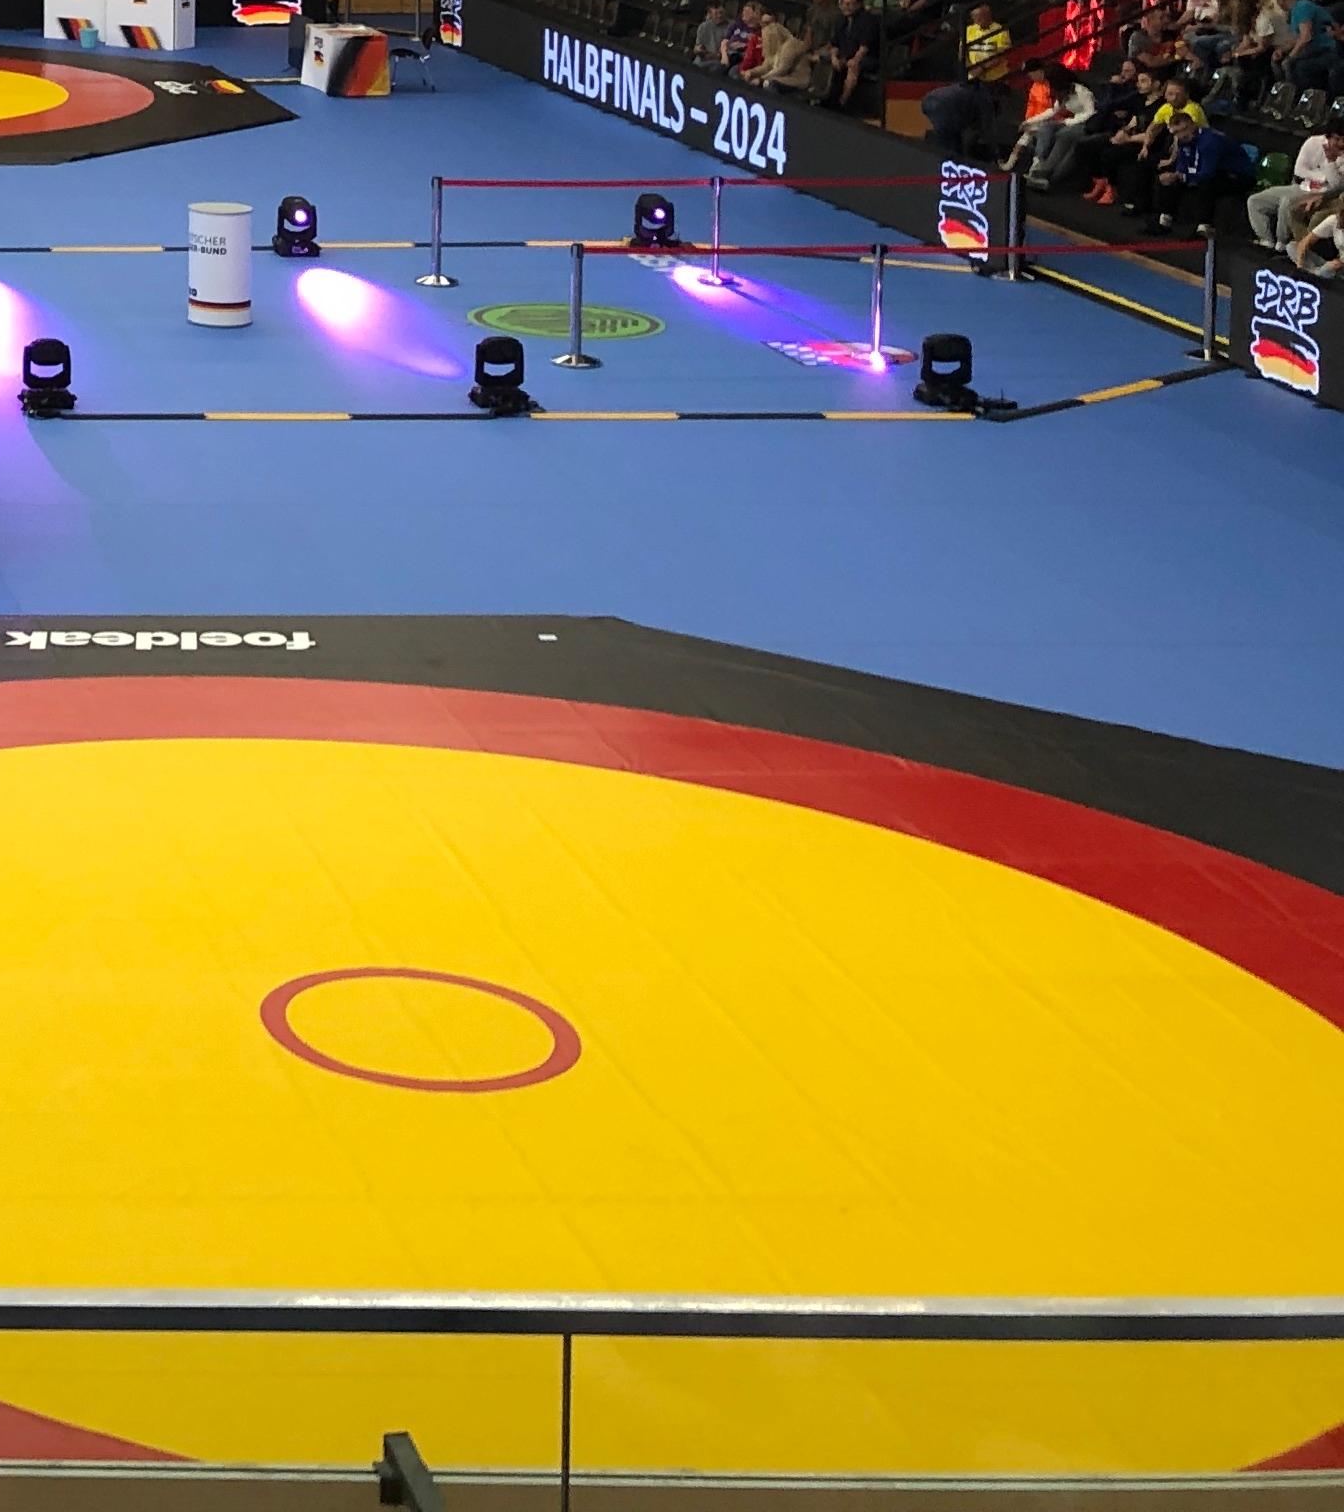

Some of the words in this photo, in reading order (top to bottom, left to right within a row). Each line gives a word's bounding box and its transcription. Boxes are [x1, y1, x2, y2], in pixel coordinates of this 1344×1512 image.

[543, 28, 685, 134] HALBFINALS
[713, 90, 787, 176] 2024
[1254, 269, 1321, 325] DRB
[4, 630, 317, 651] foeldeak
